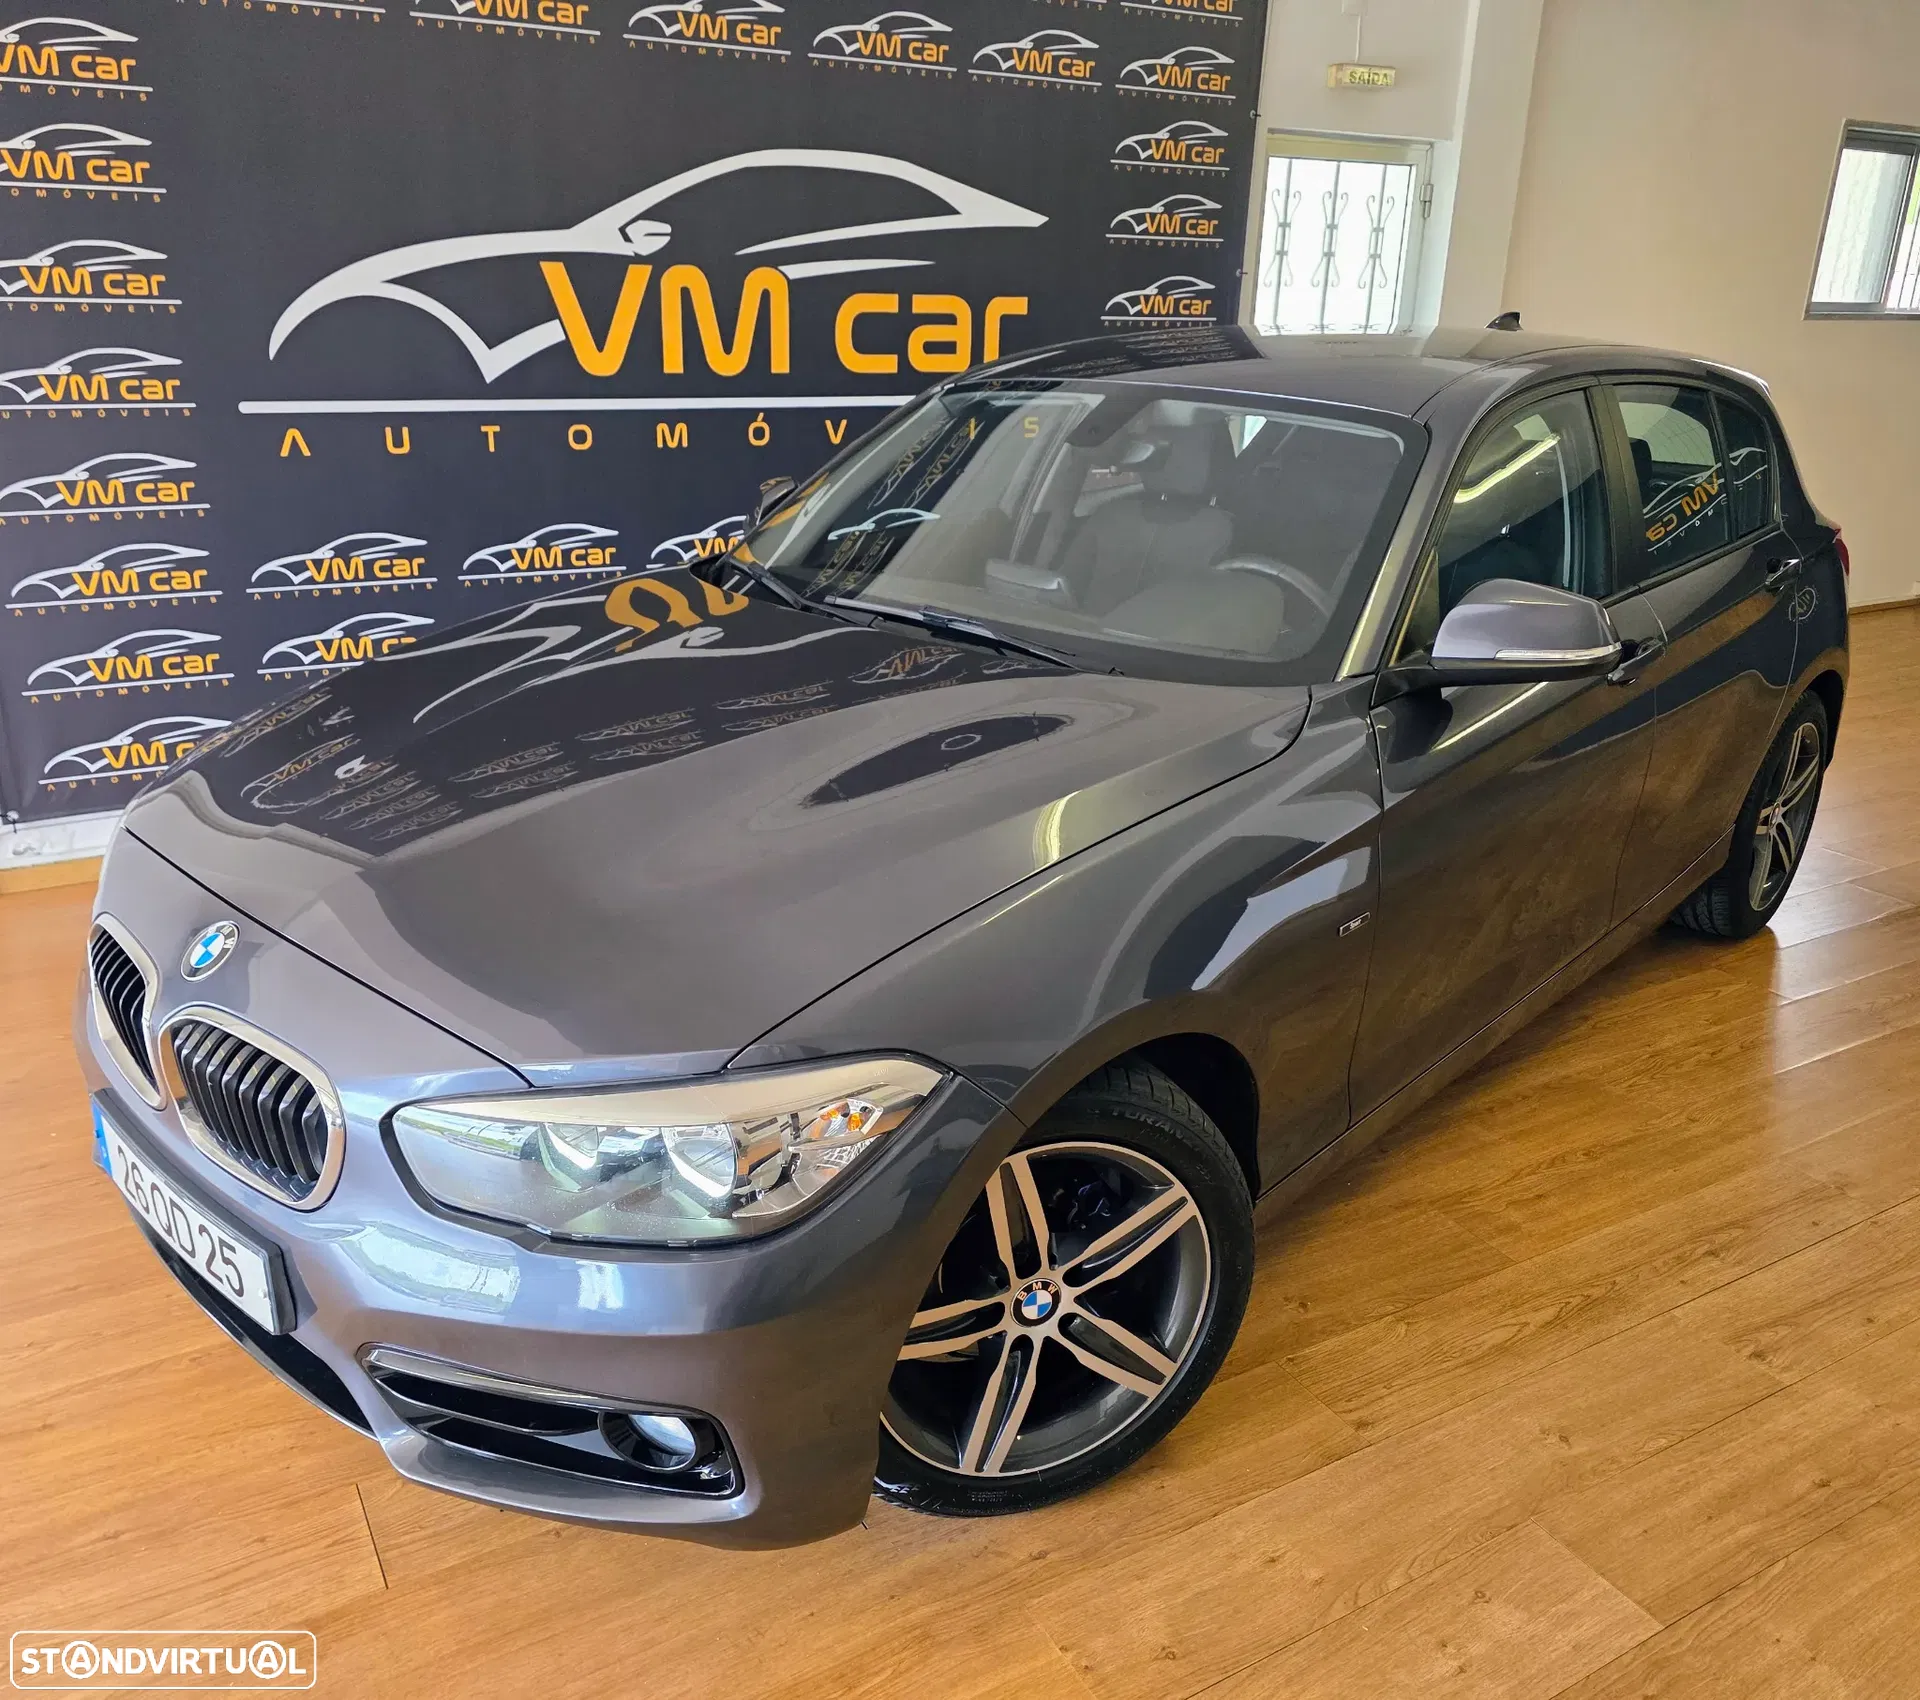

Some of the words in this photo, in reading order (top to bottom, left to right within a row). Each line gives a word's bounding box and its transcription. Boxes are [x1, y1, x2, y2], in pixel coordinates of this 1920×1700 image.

[474, 0, 528, 19] VM
[538, 0, 587, 24] car
[678, 11, 727, 40] VM
[736, 23, 780, 45] car
[857, 32, 901, 58] VM
[909, 42, 947, 62] car
[71, 55, 136, 81] car
[1013, 48, 1052, 73] VM
[1059, 58, 1094, 77] car
[1157, 66, 1192, 86] VM
[1198, 74, 1229, 91] car
[1349, 68, 1389, 86] SAÍDA
[1152, 140, 1186, 160] VM
[1192, 147, 1223, 163] car
[0, 149, 75, 180] VM
[86, 159, 148, 183] car
[1146, 214, 1180, 233] VM
[1186, 219, 1216, 234] car
[20, 266, 92, 295] VM
[104, 273, 164, 295] car
[1141, 295, 1174, 314] VM
[1180, 300, 1209, 314] car
[540, 261, 789, 376] VM
[835, 293, 1028, 373] car
[39, 374, 109, 401] VM
[120, 379, 179, 400] car
[56, 480, 125, 506] VM
[136, 482, 193, 503] car
[307, 557, 364, 582] VM
[374, 558, 423, 578] car
[512, 546, 562, 570] VM
[571, 548, 614, 566] car
[73, 569, 139, 596] VM
[149, 570, 205, 591] car
[316, 636, 373, 661] VM
[88, 655, 152, 682] VM
[163, 654, 218, 675] car
[102, 741, 166, 768] VM
[118, 1145, 149, 1215] 26
[199, 1224, 245, 1298] 25
[1017, 1281, 1058, 1301] BMW
